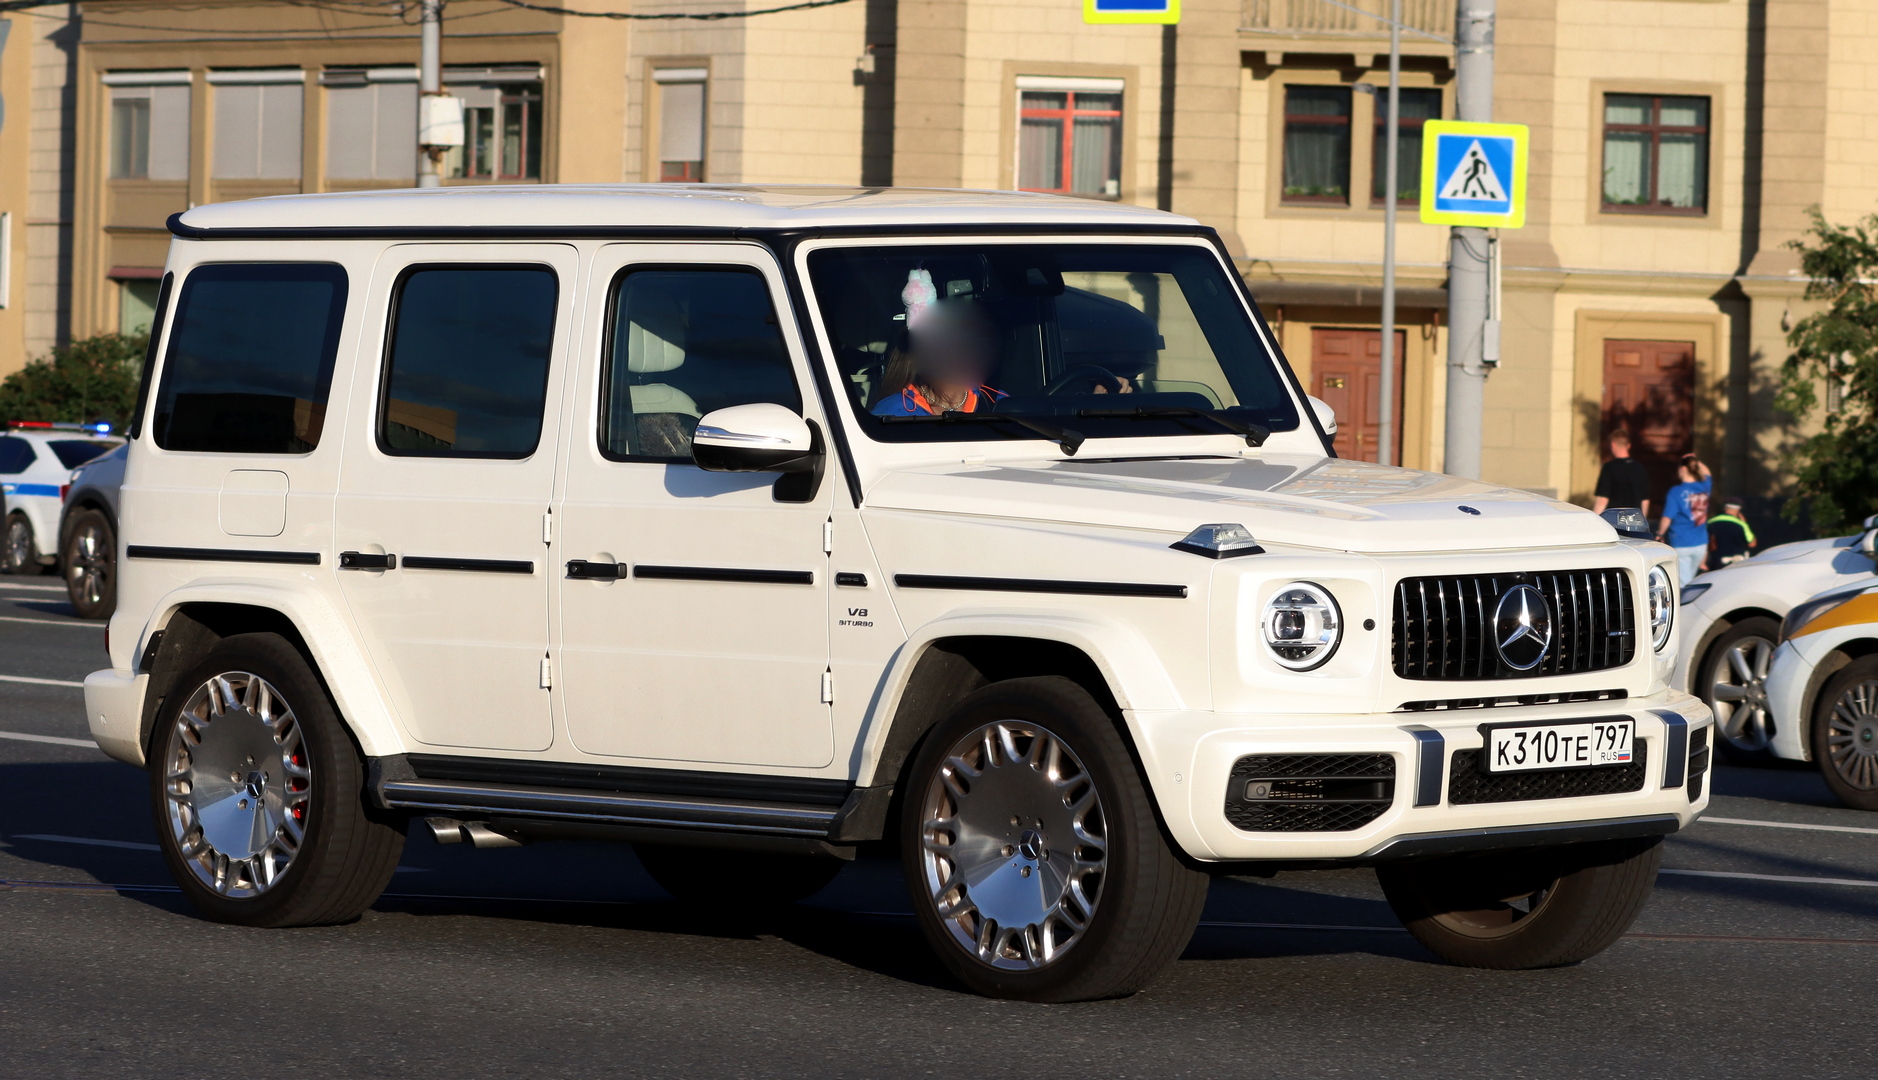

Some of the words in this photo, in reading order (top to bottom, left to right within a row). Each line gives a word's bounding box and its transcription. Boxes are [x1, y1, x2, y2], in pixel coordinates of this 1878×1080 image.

[848, 608, 868, 616] V8
[1594, 724, 1629, 751] 797
[1601, 751, 1618, 761] RUS
